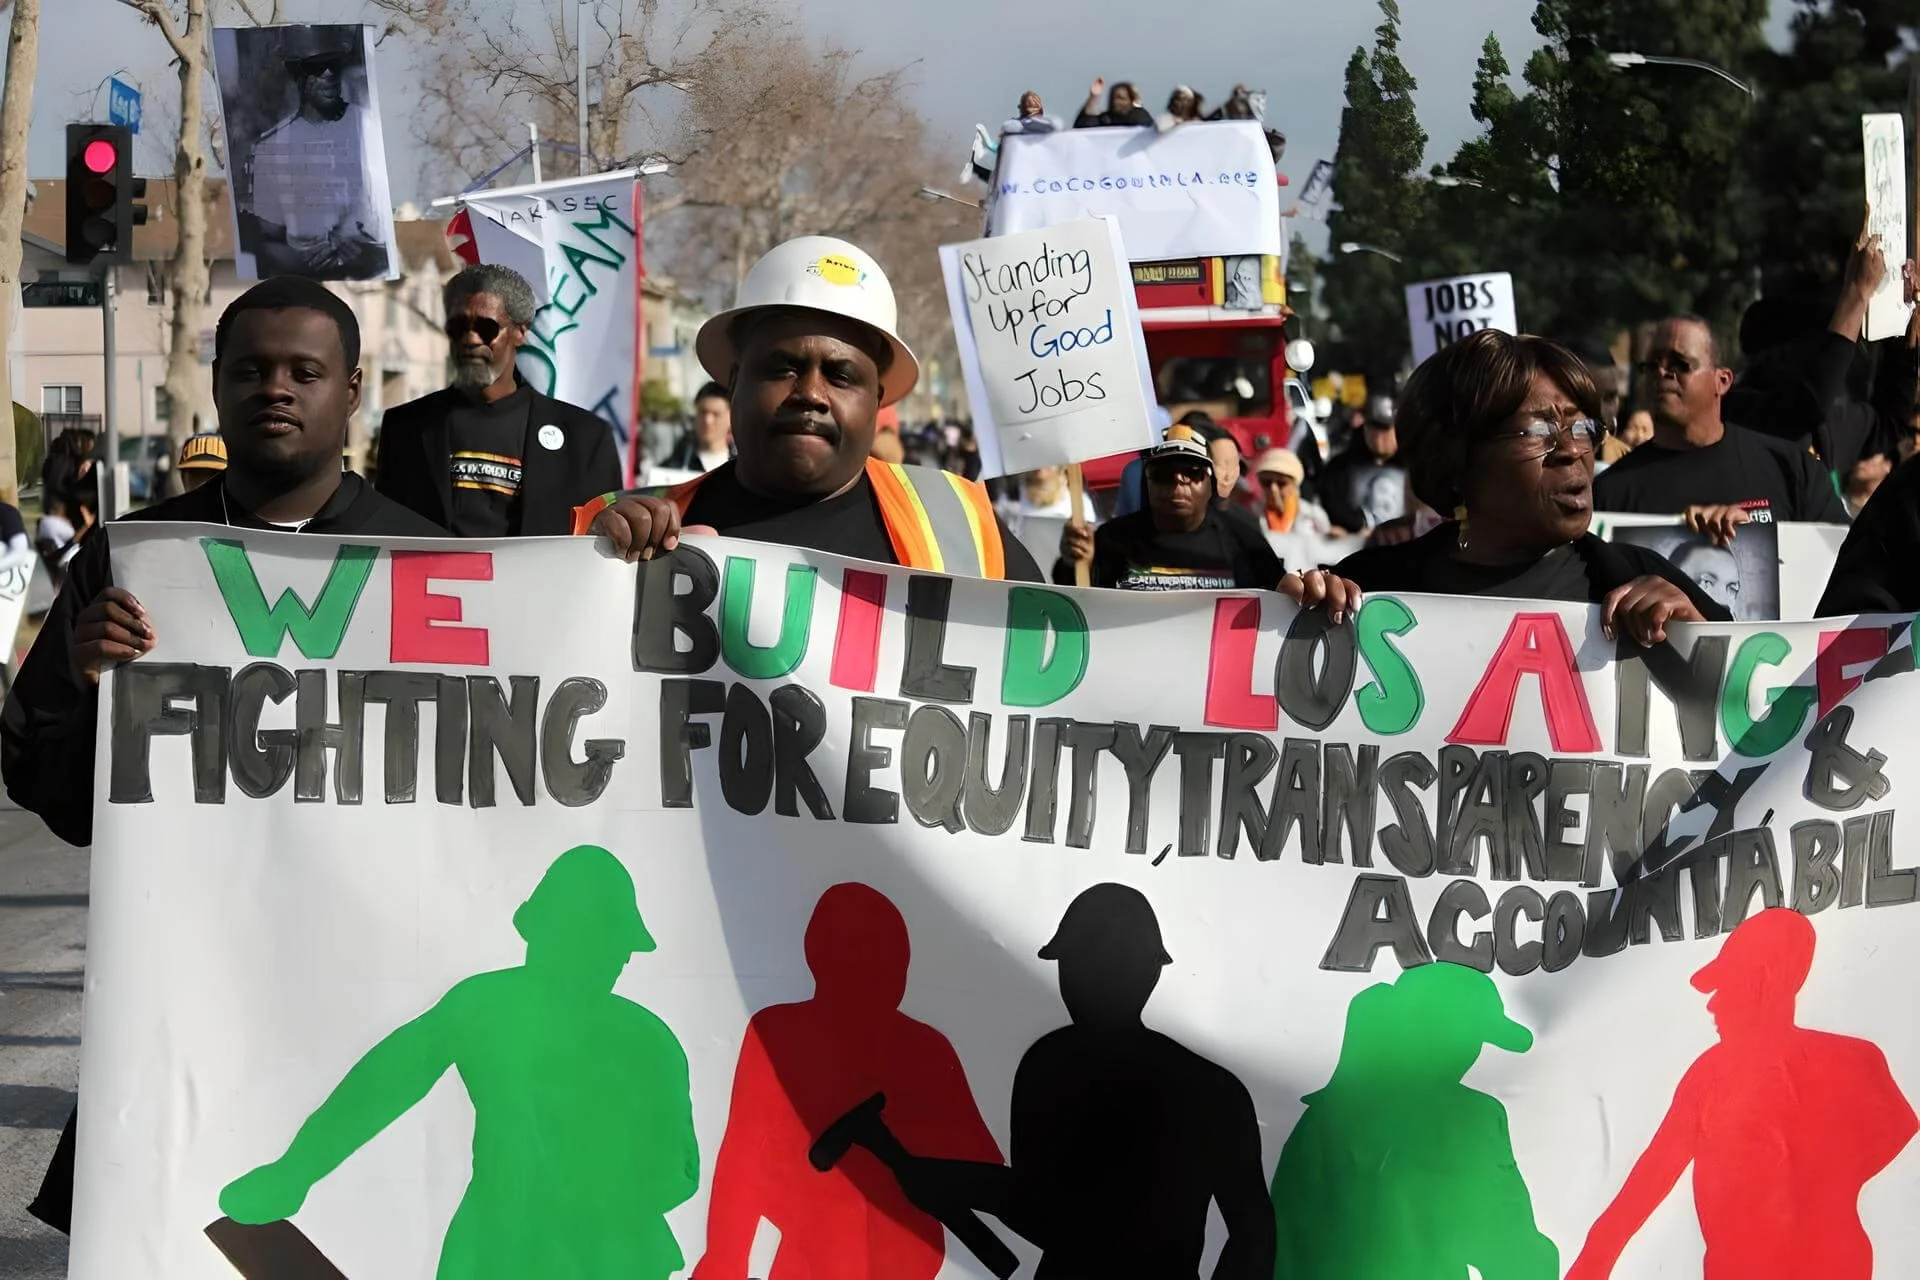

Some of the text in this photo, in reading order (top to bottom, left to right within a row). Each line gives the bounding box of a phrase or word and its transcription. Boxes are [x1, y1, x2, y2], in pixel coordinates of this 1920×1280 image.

[963, 242, 1092, 303] Standing
[1424, 279, 1495, 324] JOBS
[988, 289, 1078, 345] Up for
[1030, 309, 1113, 358] Good
[1014, 368, 1107, 414] Jobs
[200, 537, 1920, 762] WE BUILD LOS ANGE
[108, 661, 626, 809] FIGHTING
[660, 676, 836, 821] FOR
[843, 696, 1181, 868] EQUITY,
[1802, 704, 1892, 812] &
[1318, 809, 1920, 976] ACCOUNTABIL
